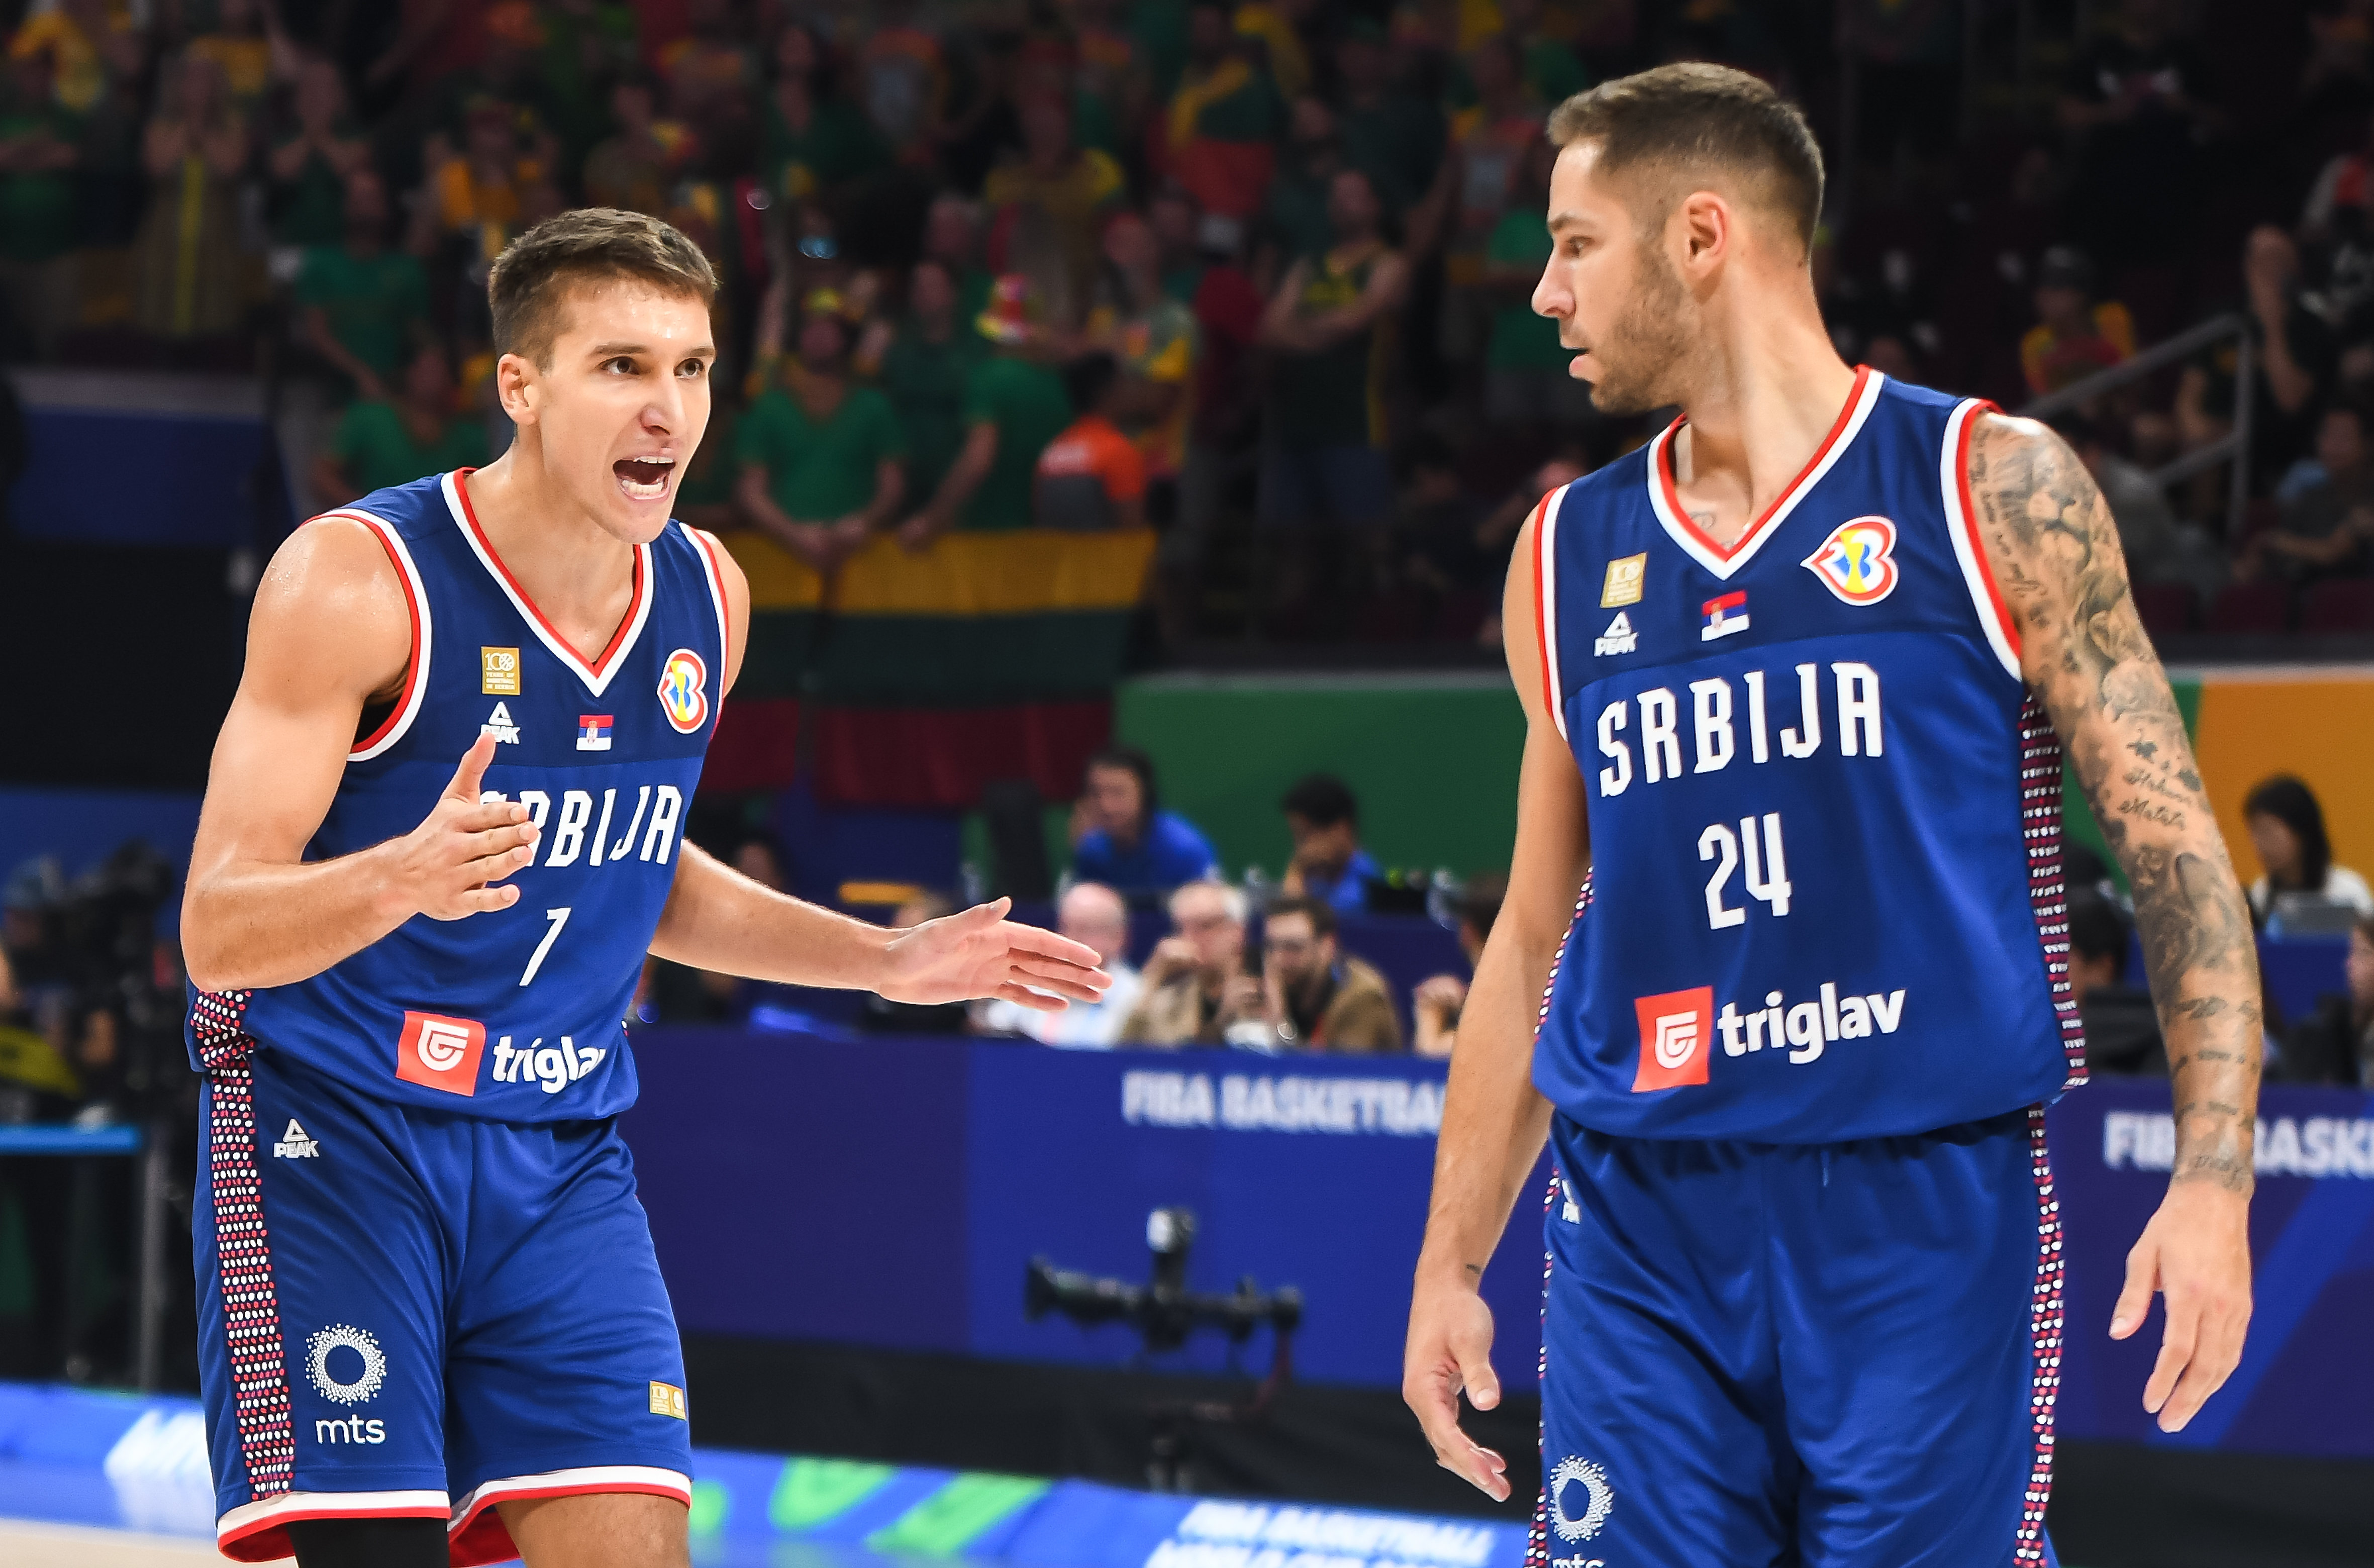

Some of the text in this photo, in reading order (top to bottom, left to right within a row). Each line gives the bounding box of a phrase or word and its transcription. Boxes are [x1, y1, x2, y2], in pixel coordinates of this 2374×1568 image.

[1594, 632, 1639, 657] PEAK
[1597, 661, 1883, 798] SRBIJA
[479, 785, 682, 867] RBIJA
[1697, 812, 1792, 930] 24
[519, 907, 571, 987] 7
[1717, 982, 1906, 1064] triglav
[1221, 1074, 1445, 1136] BASKETBA
[273, 1140, 320, 1158] PEAK
[316, 1414, 386, 1444] mts
